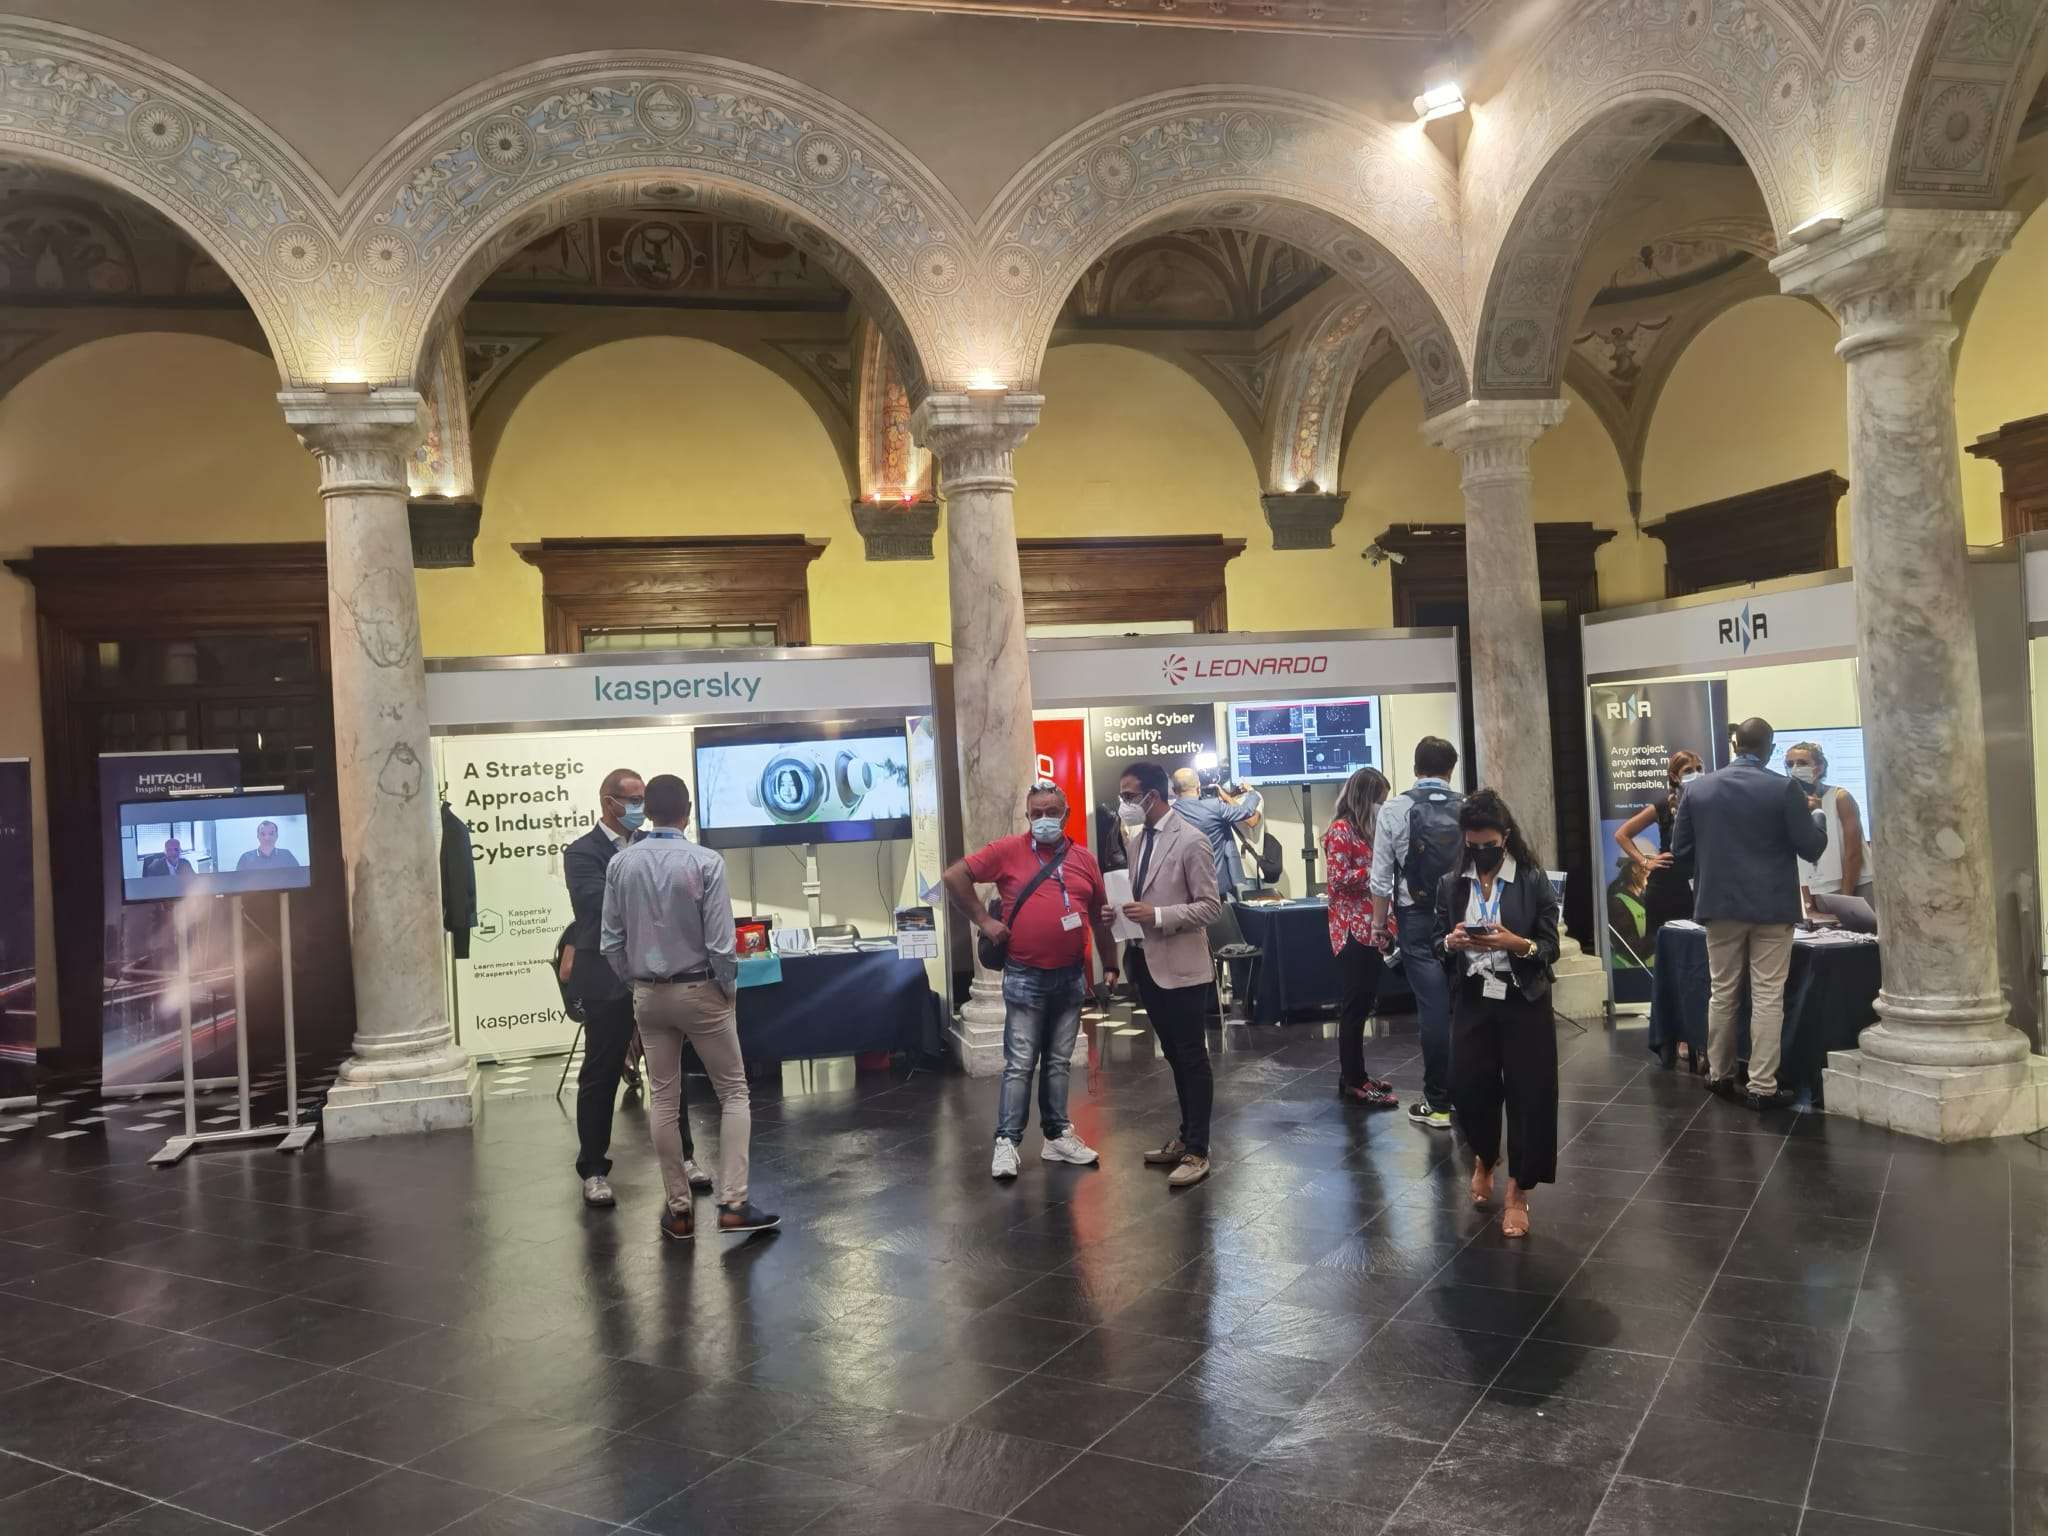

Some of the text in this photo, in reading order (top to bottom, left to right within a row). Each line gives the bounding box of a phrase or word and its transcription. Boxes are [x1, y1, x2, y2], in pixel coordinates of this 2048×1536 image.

[1719, 602, 1768, 653] RINA
[1195, 656, 1328, 677] LEONARDO
[595, 672, 761, 705] kaspersky
[1606, 695, 1652, 723] RINA
[1104, 712, 1195, 728] Beyond Cyber
[1104, 729, 1162, 743] Security:
[1105, 741, 1204, 758] Global Security
[1611, 744, 1668, 757] Any project,
[464, 758, 584, 780] A Strategic
[1611, 757, 1658, 768] anywhere,
[139, 773, 202, 785] HITACHI
[1612, 769, 1668, 778] what seems
[136, 784, 166, 793] Inspire
[1613, 780, 1665, 791] impossible,
[465, 785, 569, 810] Approach
[467, 810, 595, 833] to Industrial
[471, 842, 568, 865] Cybersec
[508, 907, 552, 917] Kaspersky
[509, 916, 548, 926] Industrial
[510, 925, 565, 936] CyberSecurit
[476, 1008, 567, 1030] kaspersky
